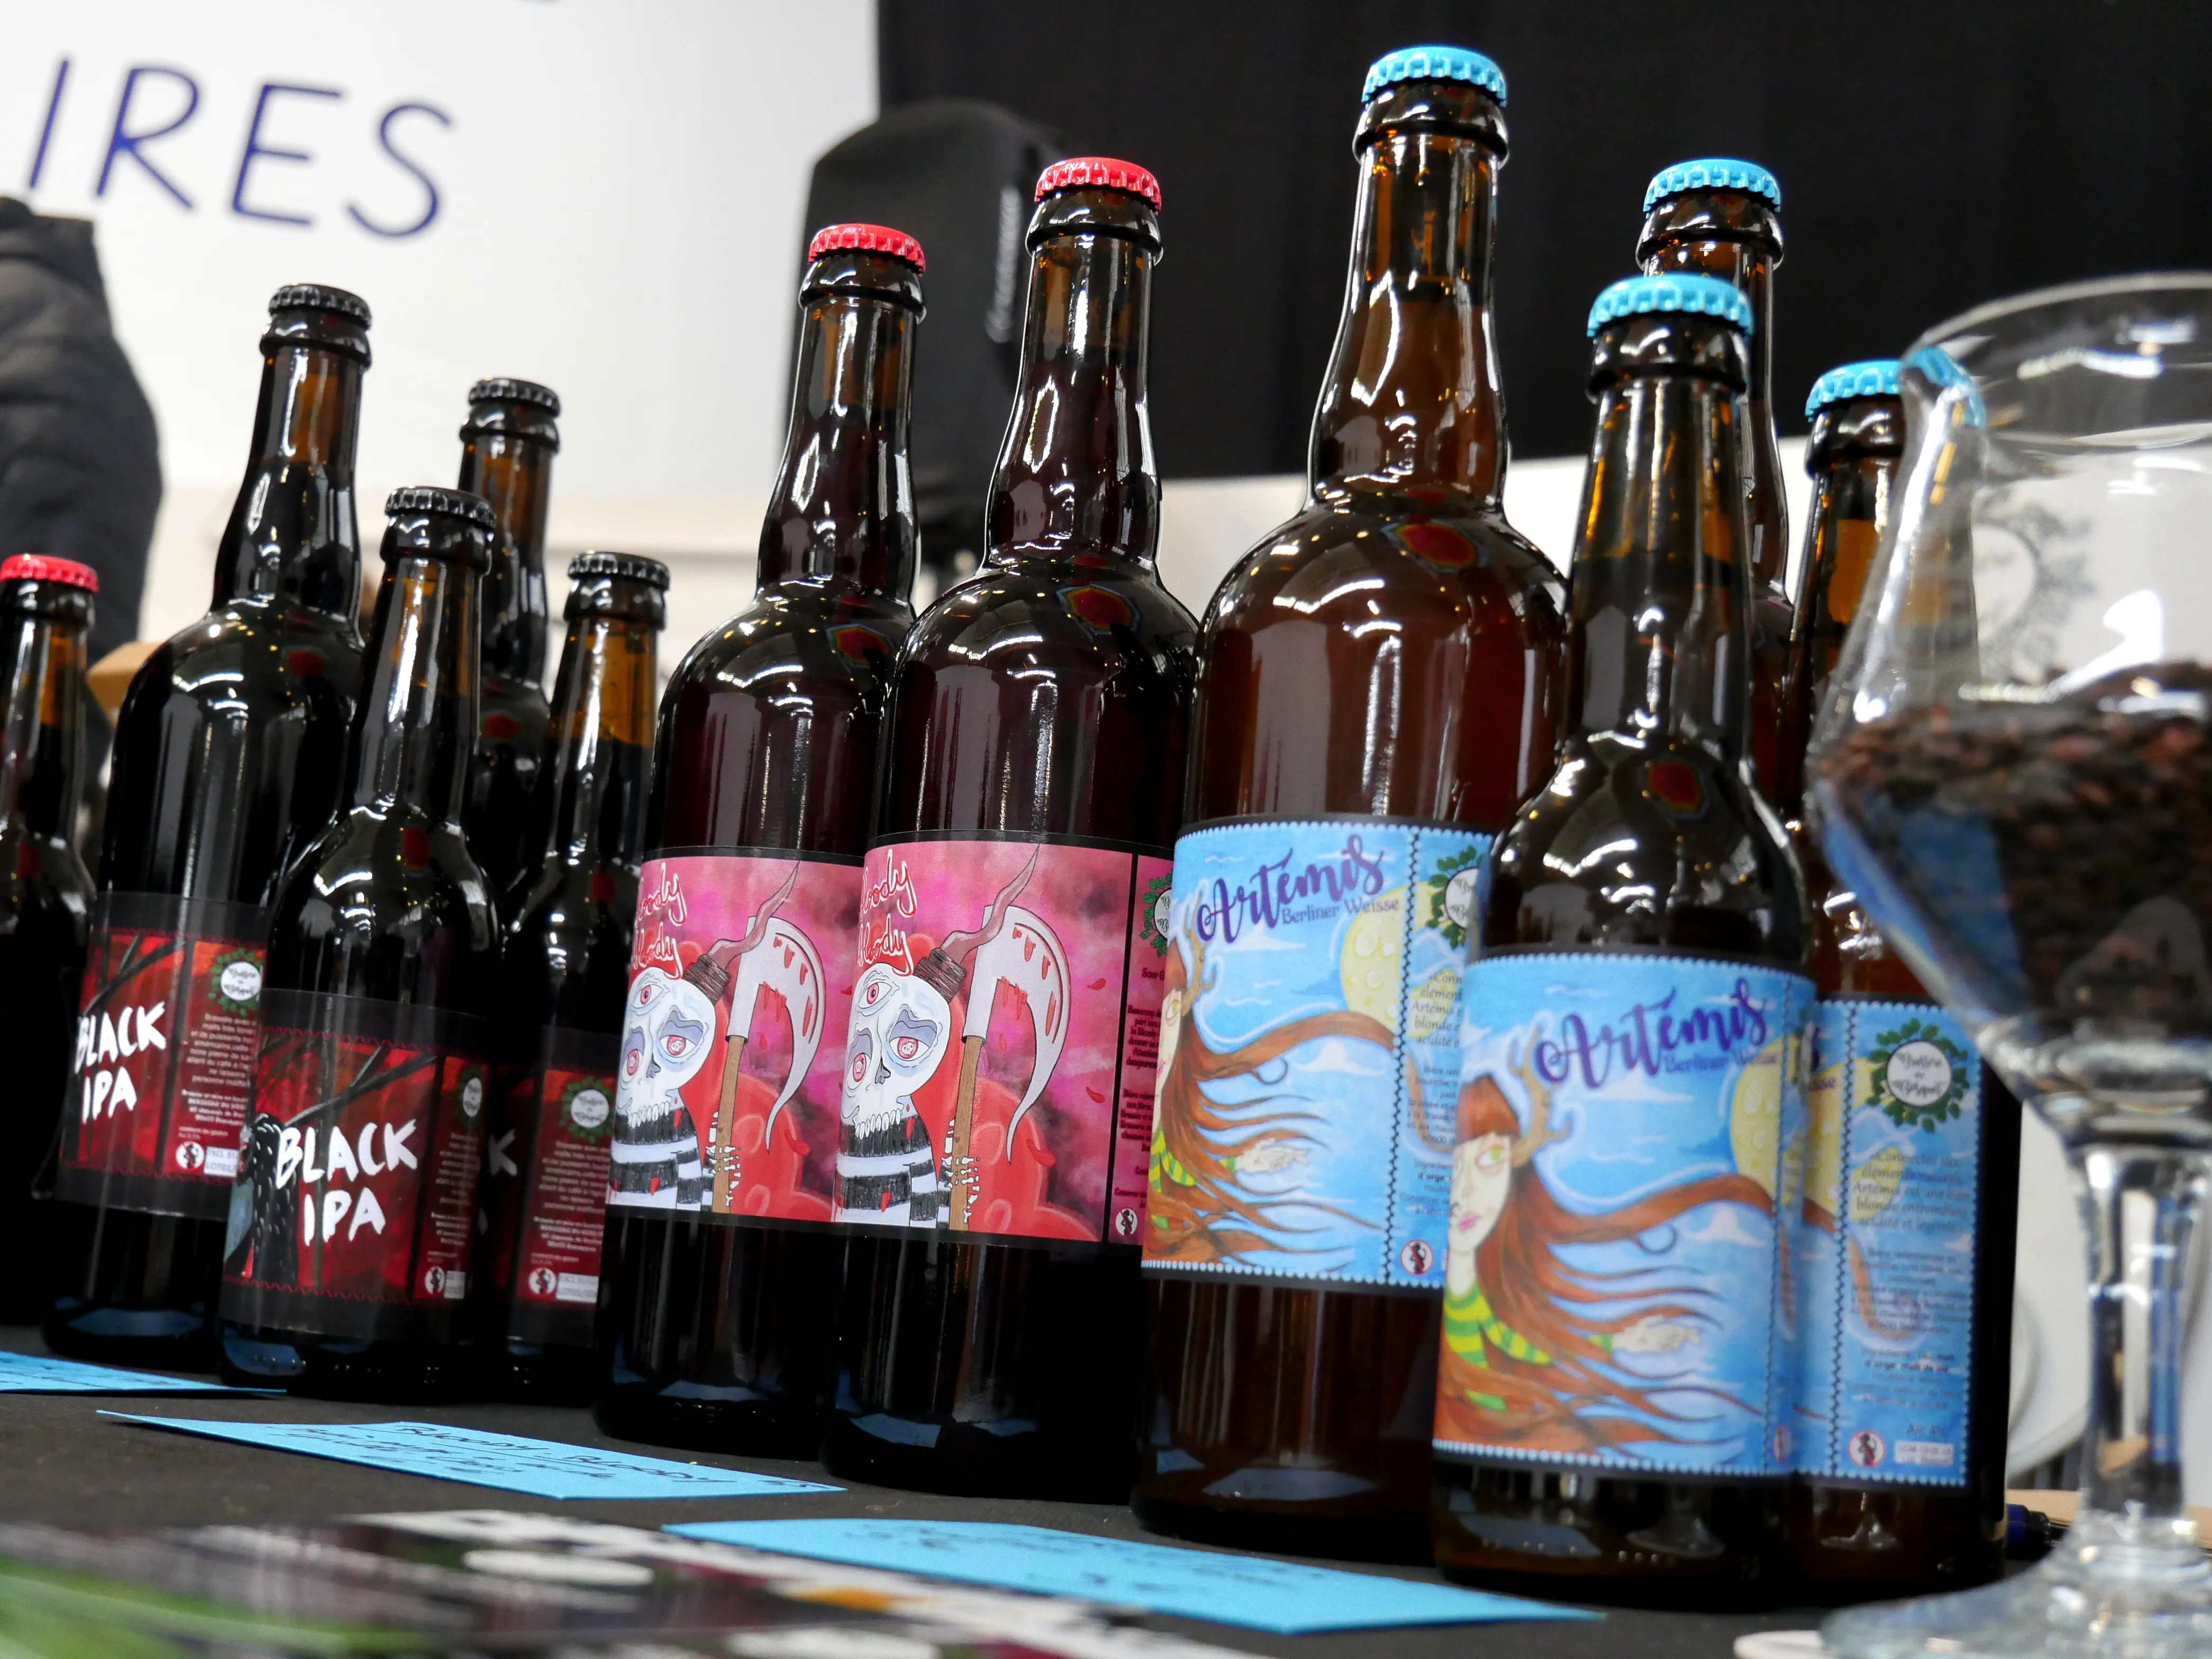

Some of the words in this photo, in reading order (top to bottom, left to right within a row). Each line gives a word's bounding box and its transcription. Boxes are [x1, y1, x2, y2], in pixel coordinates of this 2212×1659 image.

[28, 57, 453, 239] IRES
[1281, 905, 1340, 925] Berliner
[1346, 896, 1400, 915] Weisse
[1142, 967, 1159, 980] Sour
[73, 1000, 167, 1074] BLACK
[81, 1065, 138, 1124] IPA
[275, 1118, 418, 1190] BLACK
[301, 1186, 386, 1247] IPA
